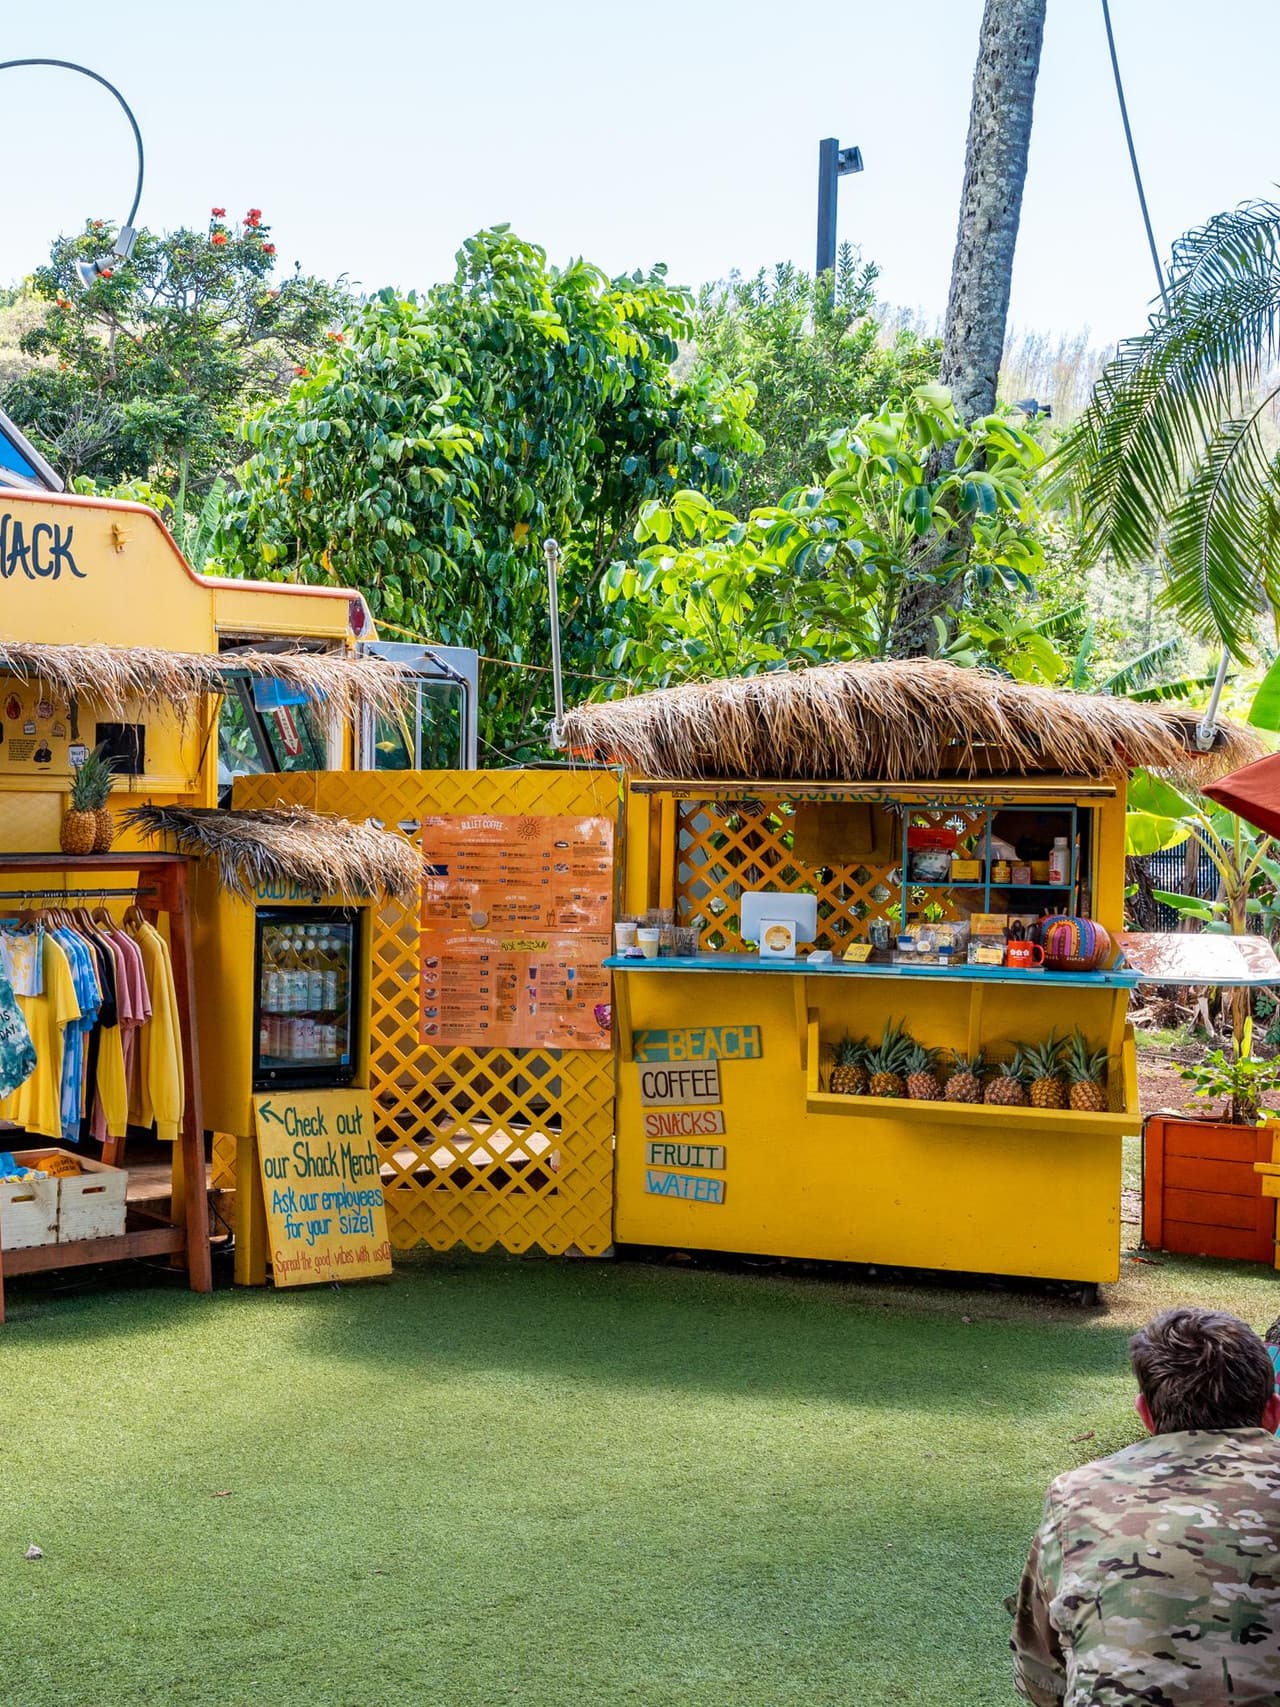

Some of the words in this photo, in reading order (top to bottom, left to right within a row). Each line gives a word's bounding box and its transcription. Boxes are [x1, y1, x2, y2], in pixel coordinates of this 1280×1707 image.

[0, 1010, 10, 1022] IS
[667, 1027, 760, 1061] BEACH
[642, 1070, 718, 1098] COFFEE
[284, 1106, 328, 1136] Check
[336, 1105, 363, 1135] out
[646, 1111, 718, 1136] SNACKS
[264, 1156, 290, 1179] our
[293, 1141, 340, 1177] Shack
[340, 1140, 380, 1184] Merch
[651, 1144, 719, 1169] FRUIT
[272, 1186, 298, 1214] Ask
[299, 1193, 319, 1212] our
[322, 1182, 384, 1216] employees
[647, 1170, 721, 1203] WATER
[284, 1213, 305, 1240] for
[305, 1218, 332, 1246] your
[339, 1208, 375, 1237] size!
[275, 1249, 300, 1280] Spread
[300, 1250, 312, 1270] the
[314, 1248, 331, 1274] good
[334, 1245, 354, 1266] vibes
[355, 1245, 370, 1263] with
